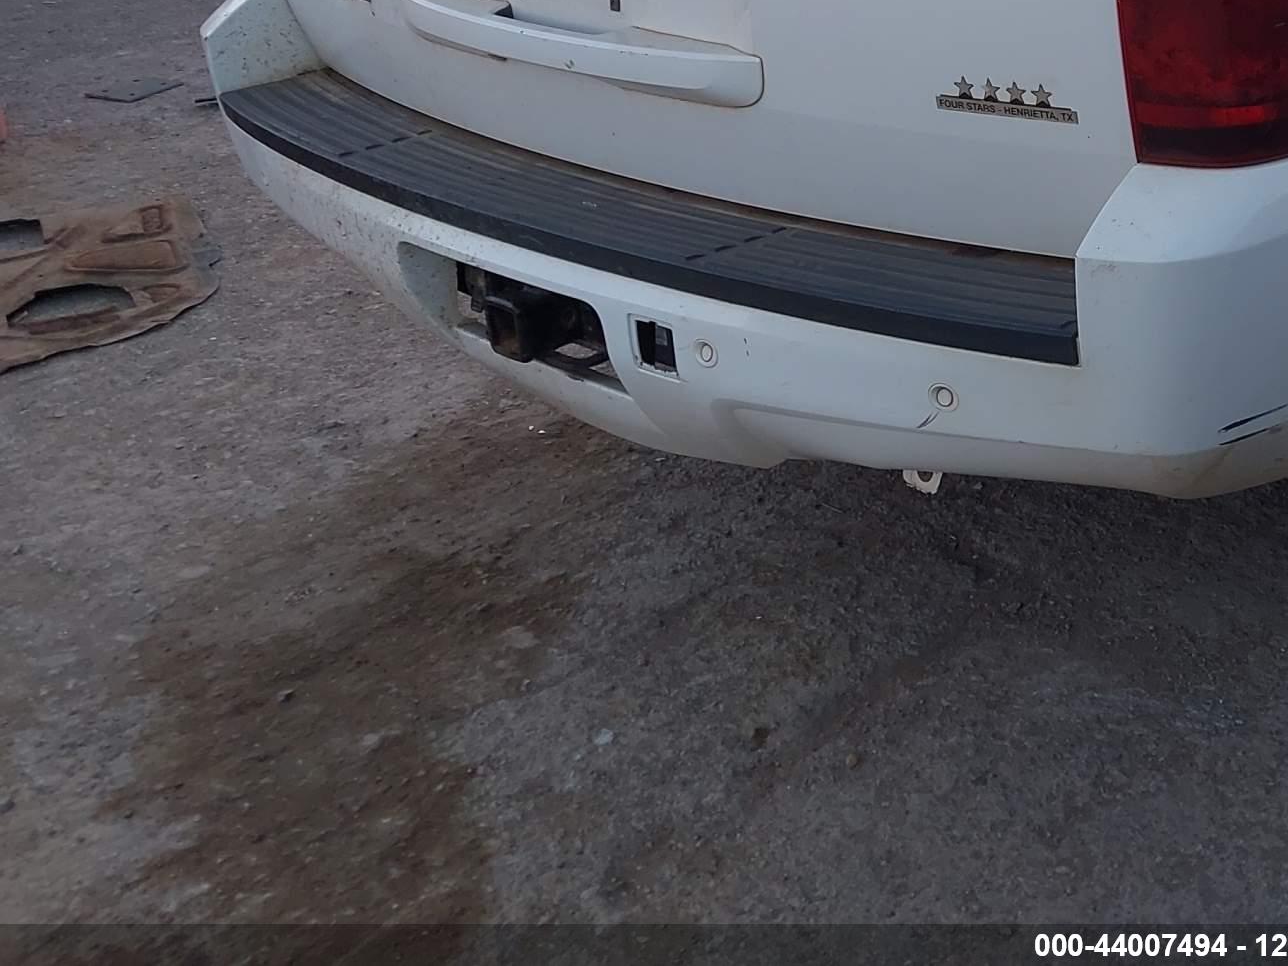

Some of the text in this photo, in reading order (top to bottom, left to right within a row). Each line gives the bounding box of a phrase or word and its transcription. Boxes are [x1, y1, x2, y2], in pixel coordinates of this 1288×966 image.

[940, 98, 964, 110] FOUR
[967, 102, 996, 114] STARS
[1004, 106, 1059, 121] HENRIETTA,
[1062, 113, 1074, 122] TX
